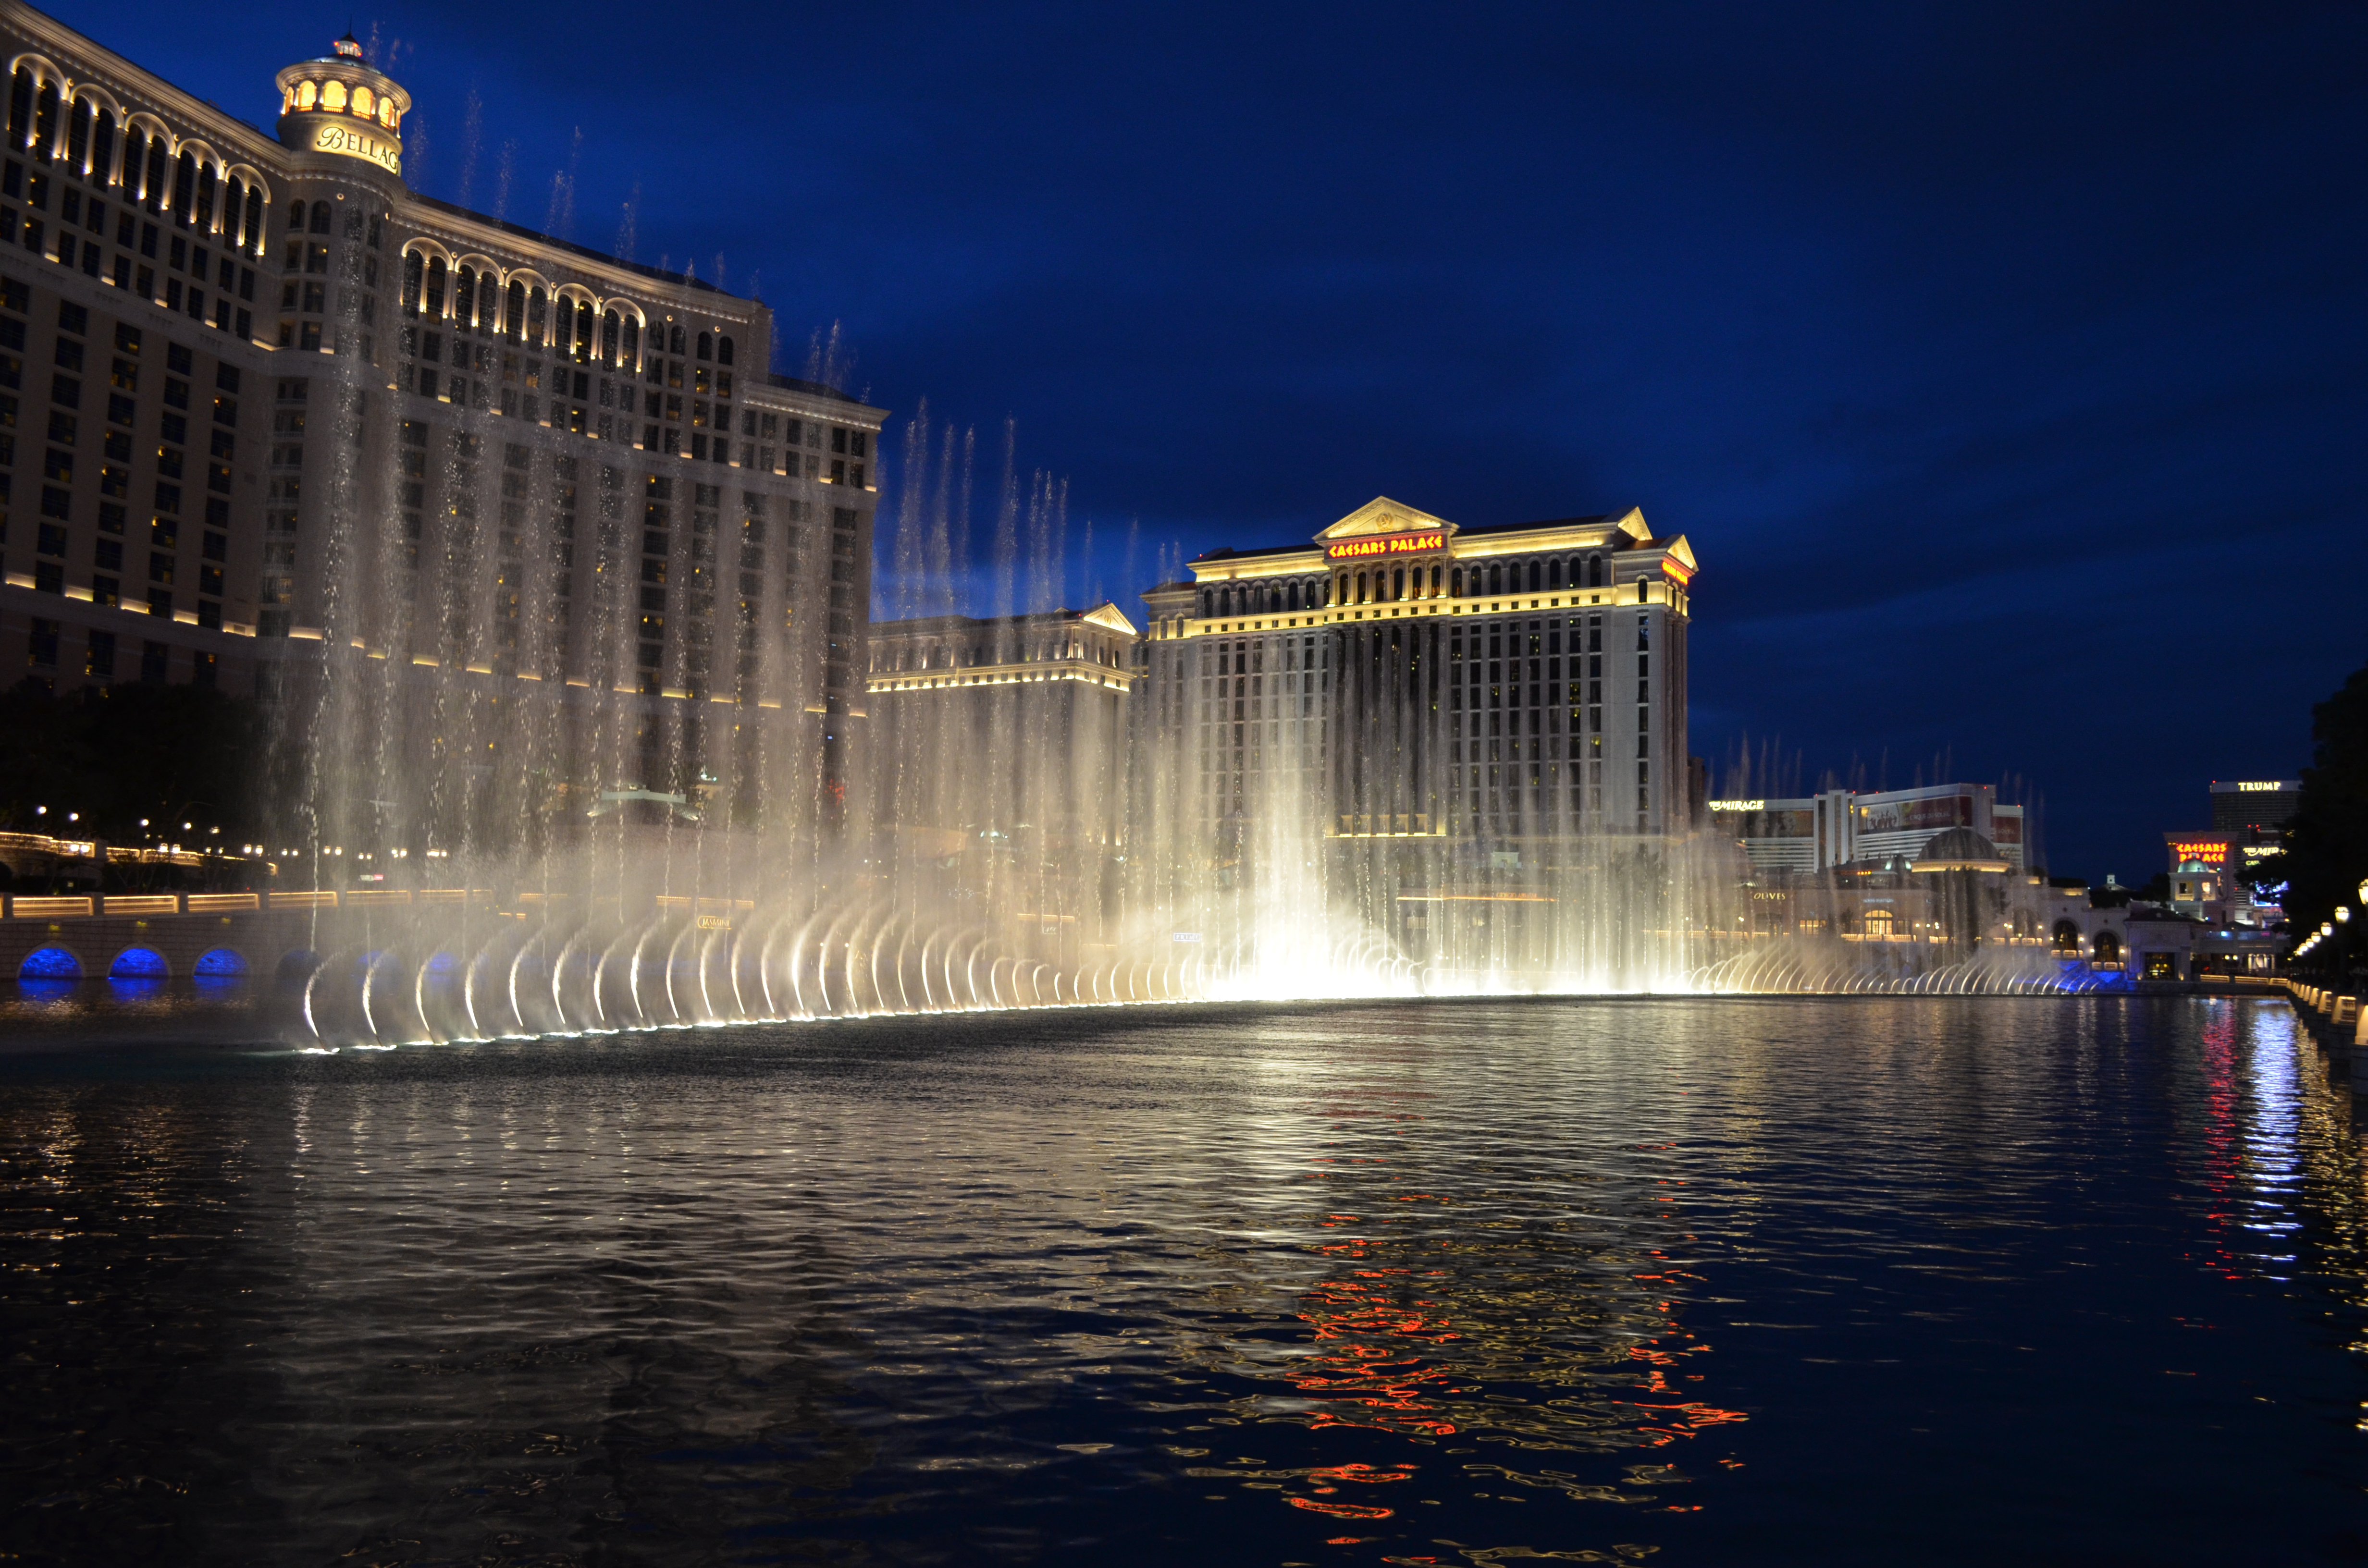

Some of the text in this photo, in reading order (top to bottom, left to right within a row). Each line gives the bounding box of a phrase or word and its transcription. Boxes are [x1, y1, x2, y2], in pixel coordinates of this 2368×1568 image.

[1329, 535, 1443, 558] CAESARS PALACE
[2238, 781, 2281, 791] TRUMP
[1712, 800, 1764, 811] MIRAGE
[2176, 843, 2227, 853] CAESARS
[2247, 847, 2288, 857] MIR
[2179, 853, 2224, 862] PACE
